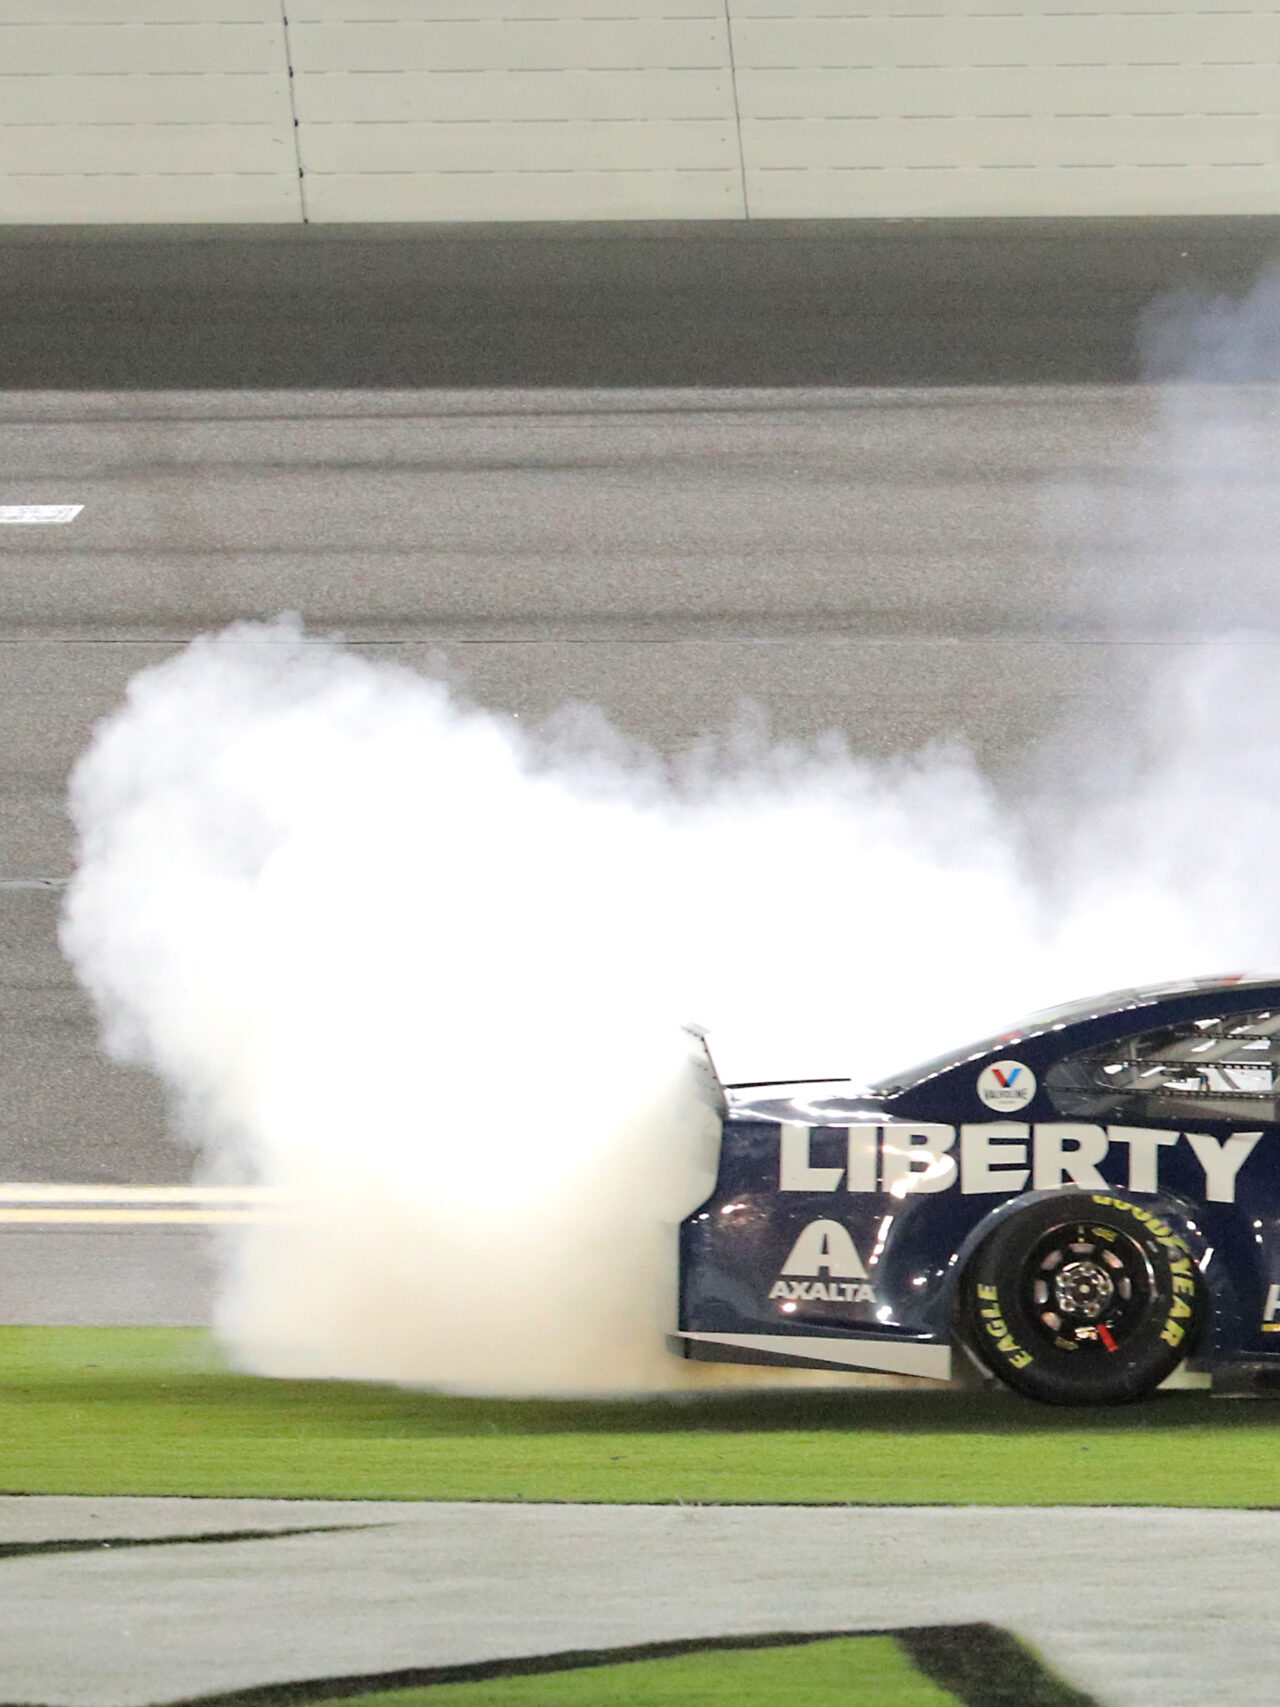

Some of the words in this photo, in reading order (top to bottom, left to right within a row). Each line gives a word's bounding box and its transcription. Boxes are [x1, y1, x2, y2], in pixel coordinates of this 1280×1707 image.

[779, 1122, 1264, 1203] LIBERTY
[768, 1281, 877, 1303] AXALTA
[977, 1284, 1034, 1369] EAGLE
